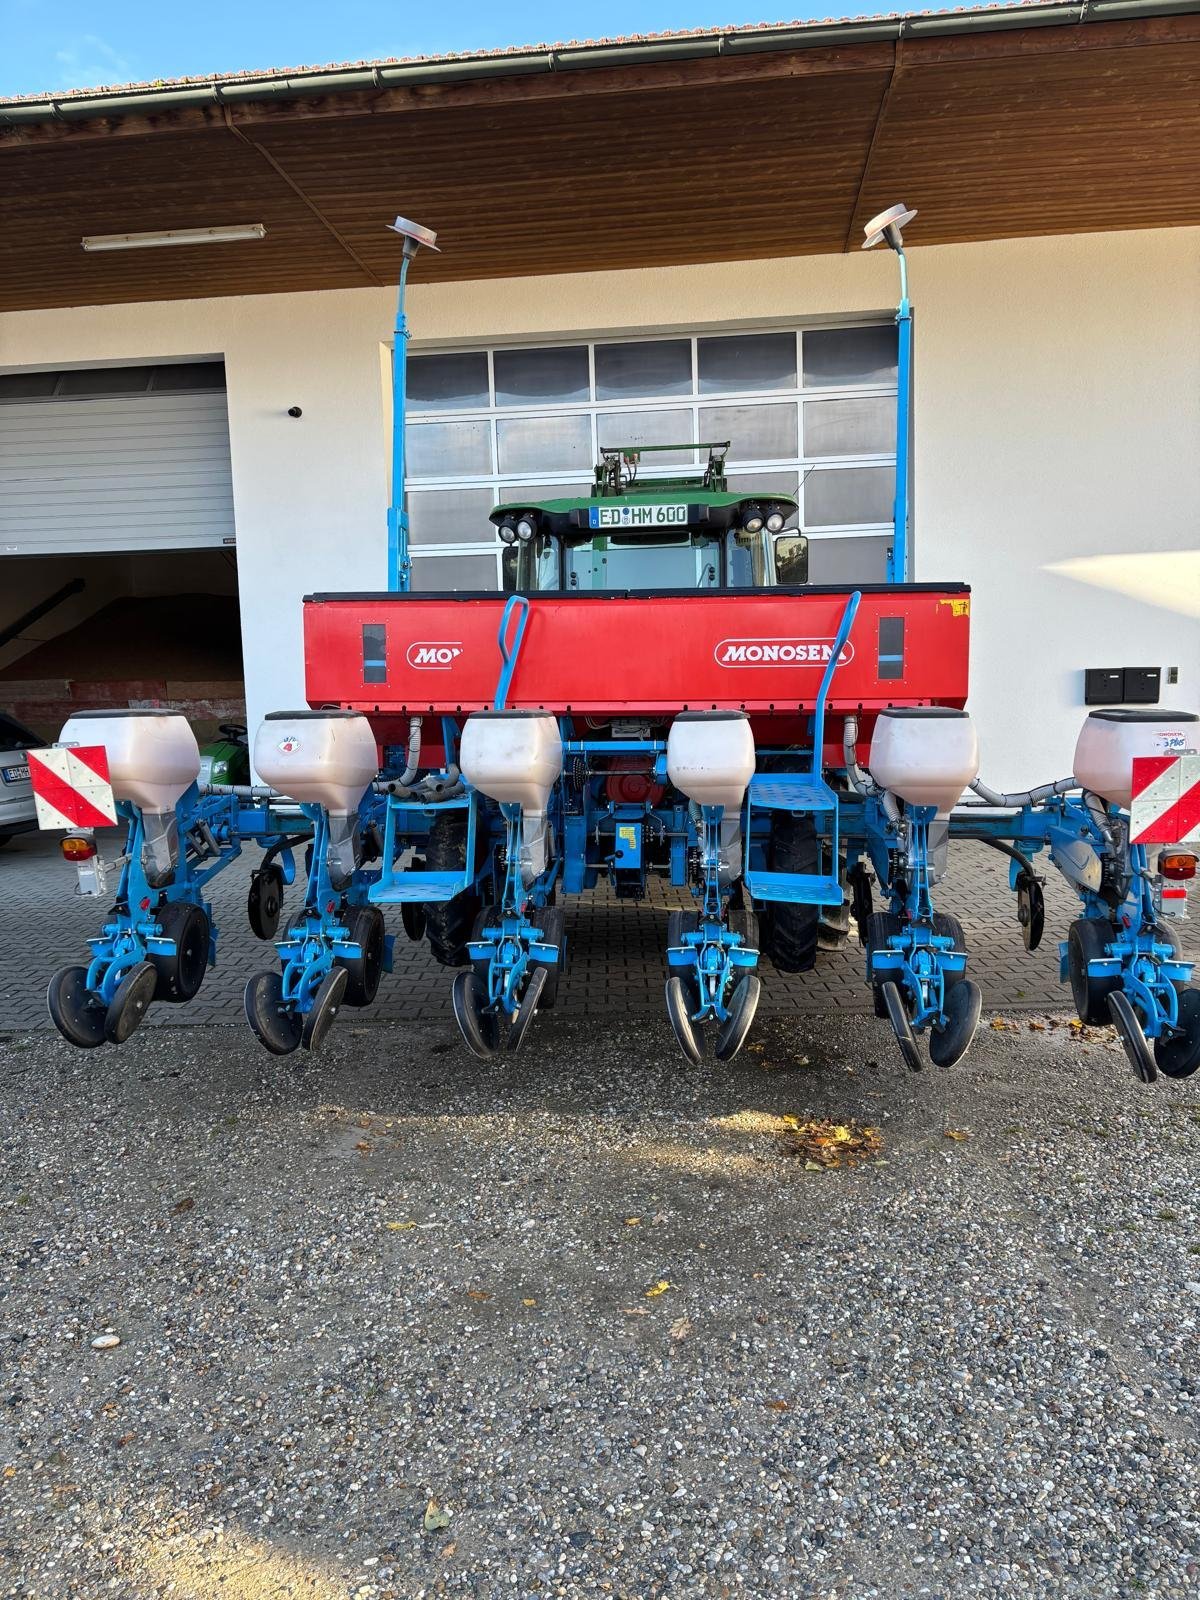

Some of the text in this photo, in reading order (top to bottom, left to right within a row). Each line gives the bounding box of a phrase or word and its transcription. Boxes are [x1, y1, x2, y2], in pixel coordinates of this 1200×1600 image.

[600, 506, 686, 525] ED HM 600
